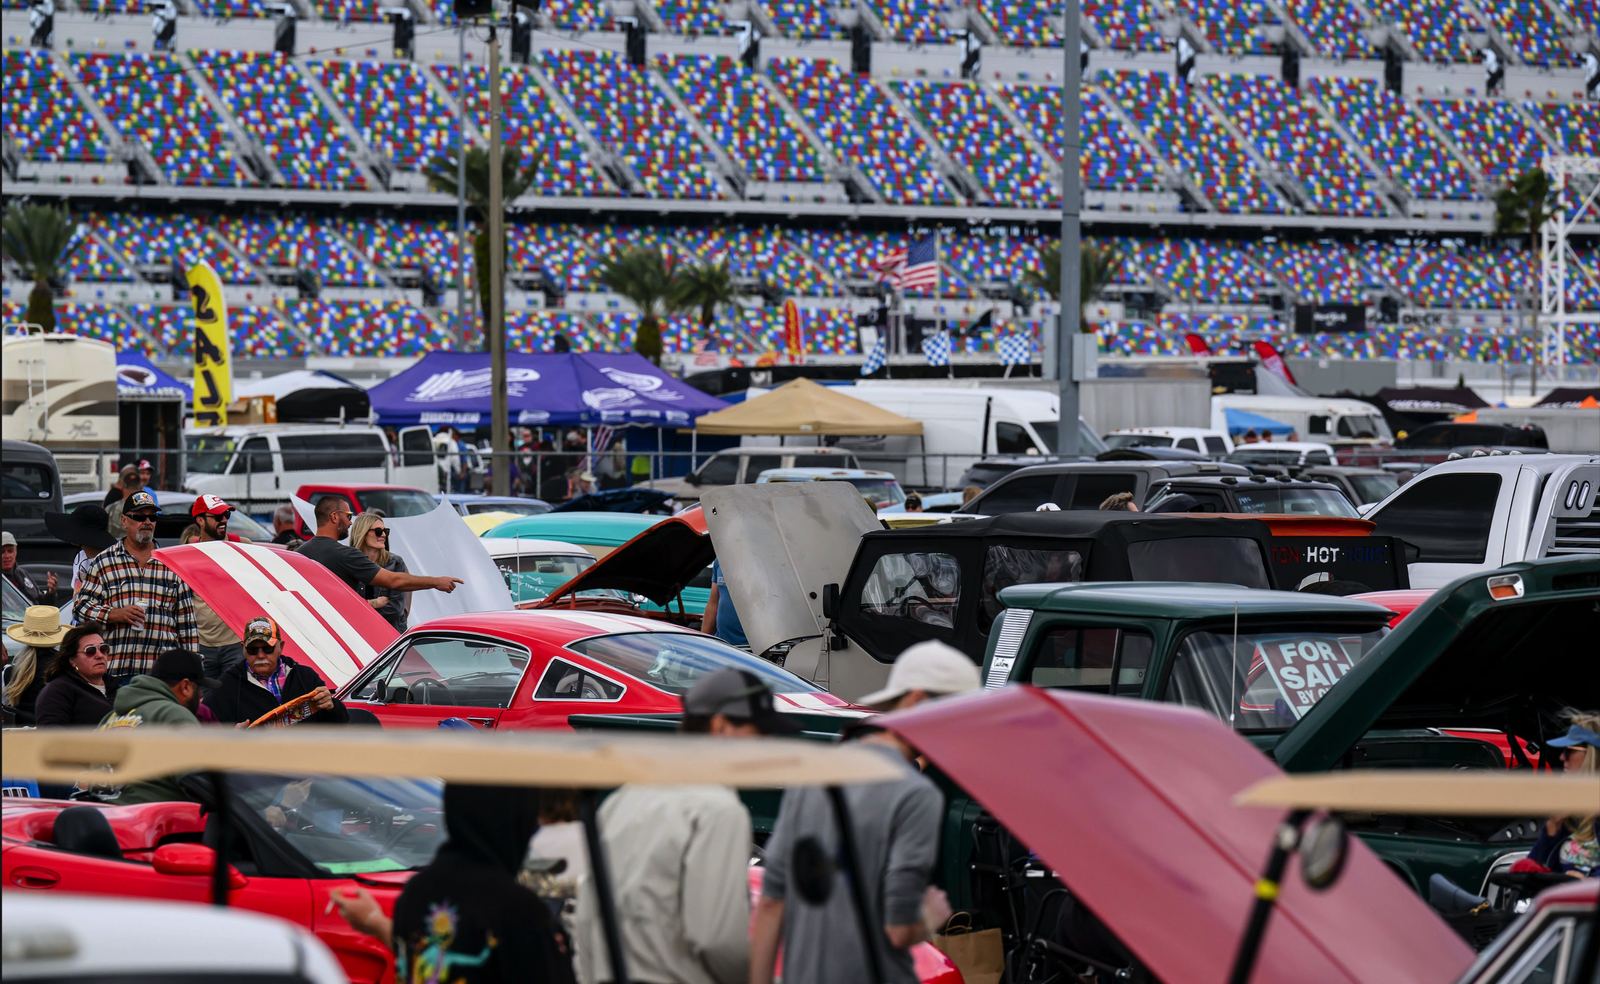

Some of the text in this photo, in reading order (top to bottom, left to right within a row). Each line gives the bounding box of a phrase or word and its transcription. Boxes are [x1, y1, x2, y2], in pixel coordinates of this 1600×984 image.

[1307, 546, 1340, 563] HOT
[1279, 640, 1338, 665] FOR
[1297, 690, 1317, 705] BY
